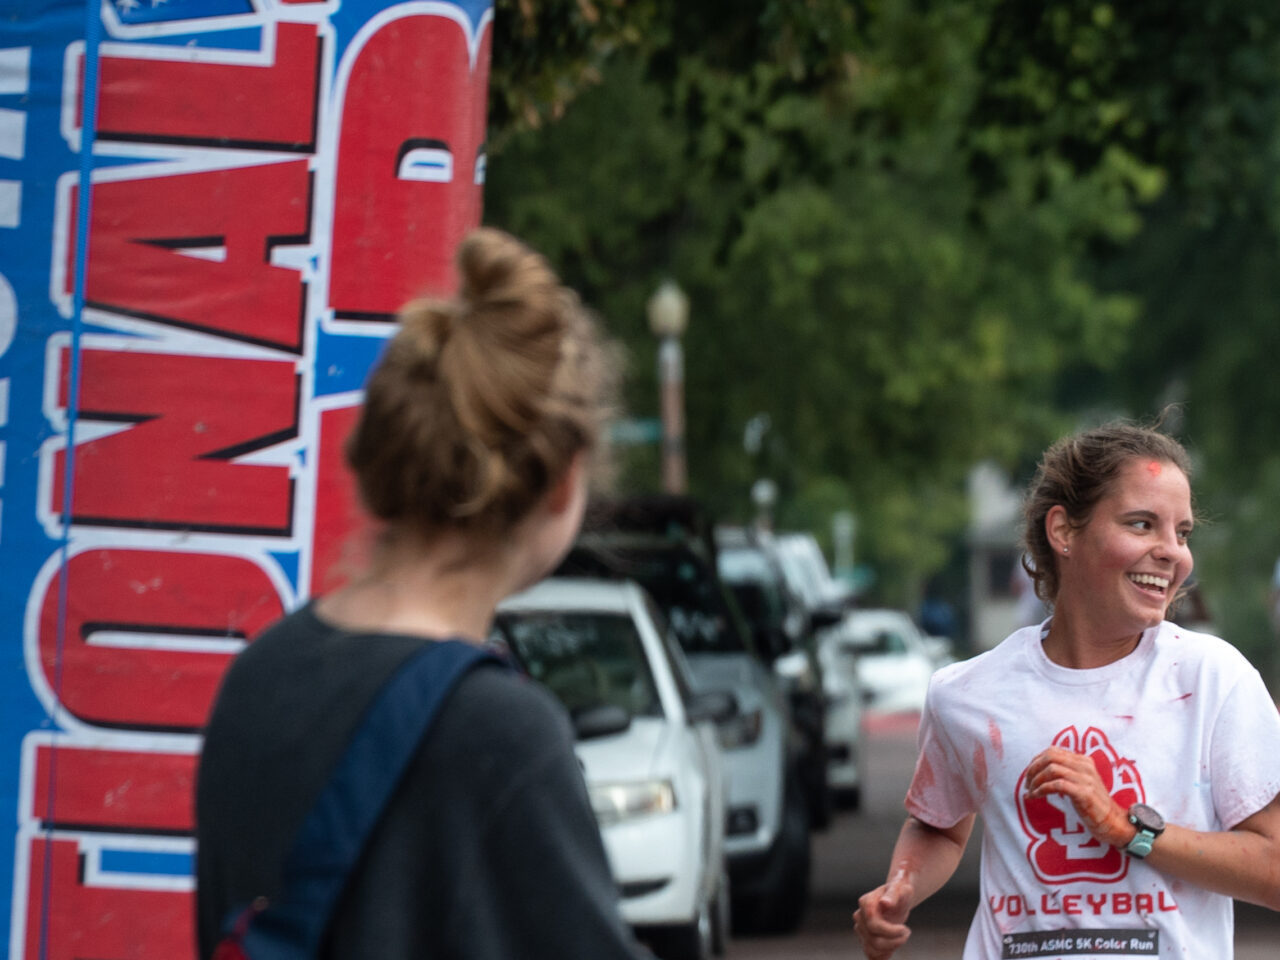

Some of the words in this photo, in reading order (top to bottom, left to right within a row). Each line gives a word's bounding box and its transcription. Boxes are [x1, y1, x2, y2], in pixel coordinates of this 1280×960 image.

[1009, 941, 1038, 955] 730th
[1040, 938, 1073, 952] ASMC
[1076, 938, 1092, 950] 5K
[1095, 937, 1128, 950] Color
[1130, 938, 1154, 951] Run
